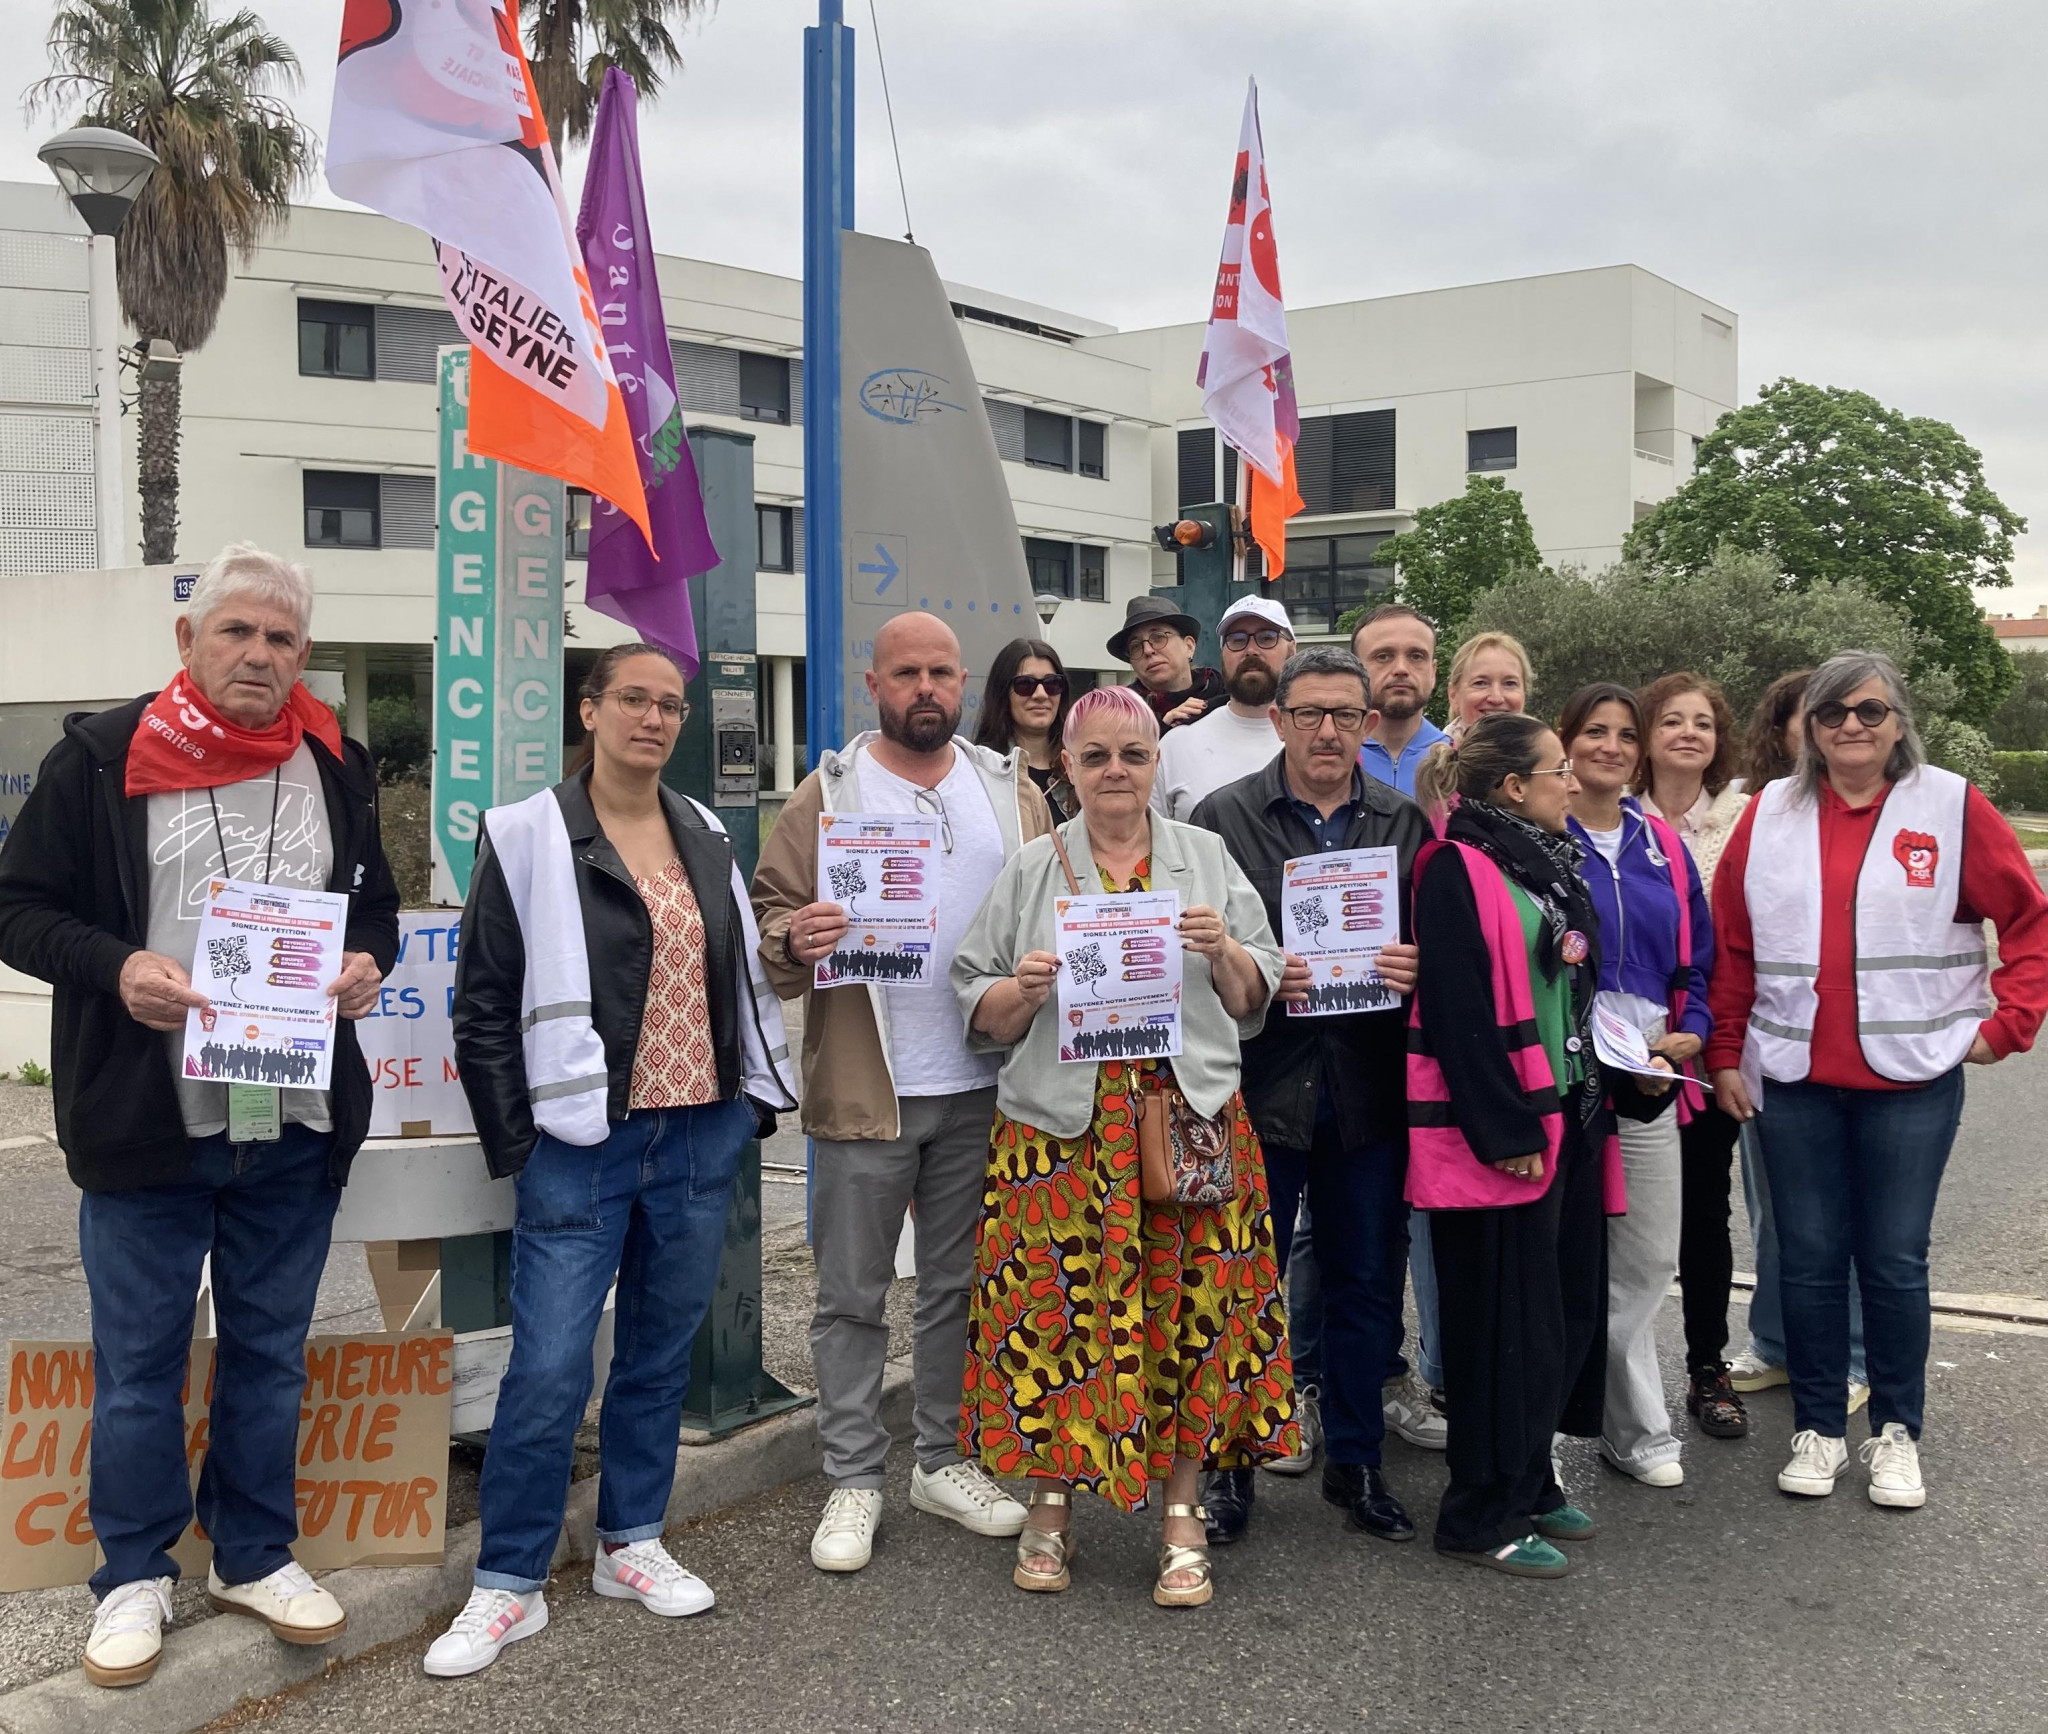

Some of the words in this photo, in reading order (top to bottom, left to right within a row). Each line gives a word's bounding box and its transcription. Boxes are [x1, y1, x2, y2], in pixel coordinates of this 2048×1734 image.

[601, 222, 646, 394] Santé
[470, 302, 578, 390] SEYNE
[144, 713, 206, 760] retraités
[1911, 868, 1931, 880] cgt
[231, 921, 258, 931] SIGNEZ
[260, 924, 270, 933] LA
[271, 926, 306, 937] PÉTITION
[208, 999, 242, 1009] OUTENEZ
[244, 1003, 270, 1011] NOTRE
[271, 1006, 320, 1016] MOUVEMENT
[1069, 1000, 1104, 1009] SOUTENEZ
[1128, 992, 1168, 1001] MOUVEMENT
[9, 1350, 95, 1415] NON
[305, 1337, 454, 1402] METURE
[2, 1420, 59, 1479] LA
